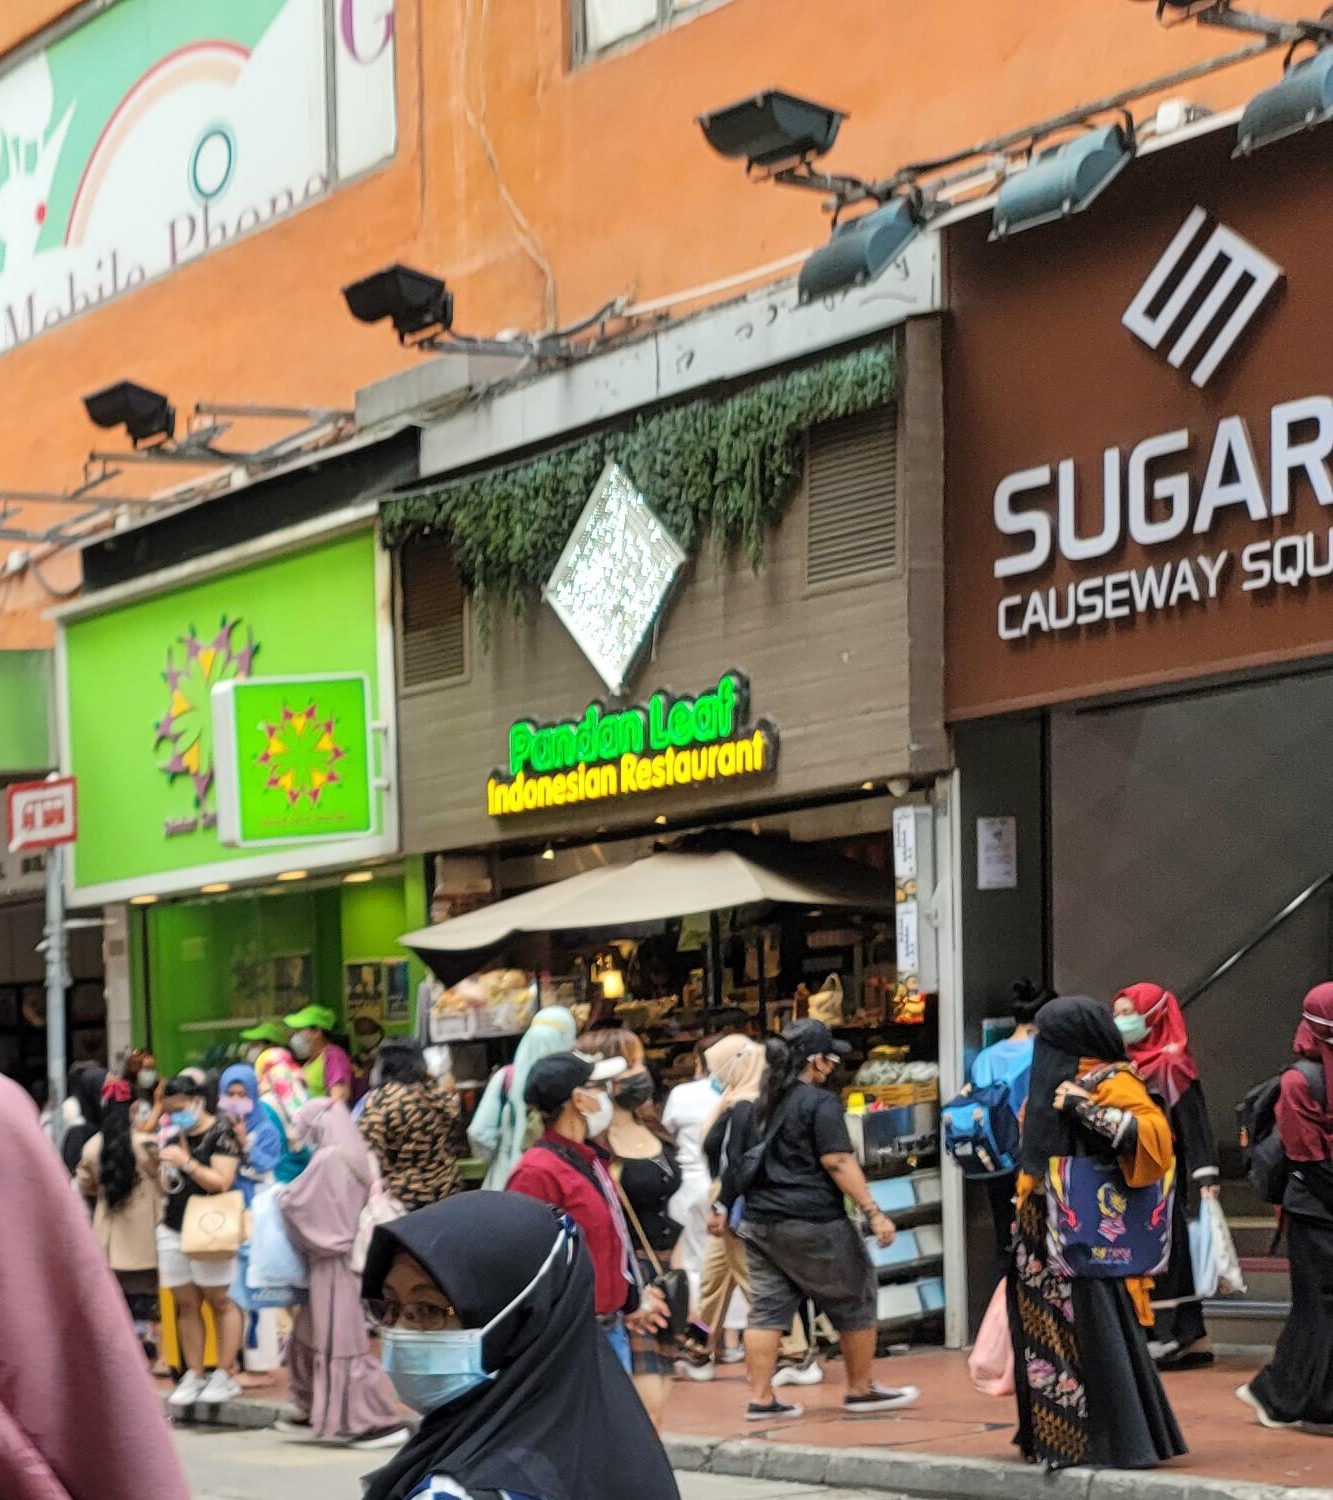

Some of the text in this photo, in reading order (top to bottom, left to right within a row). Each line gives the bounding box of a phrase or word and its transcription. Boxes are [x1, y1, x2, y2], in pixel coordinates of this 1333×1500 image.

[993, 395, 1333, 580] SUGAR
[997, 550, 1229, 640] CAUSEWAY
[487, 729, 767, 816] Indonesian Restaurant
[509, 675, 737, 777] Pandan Leaf
